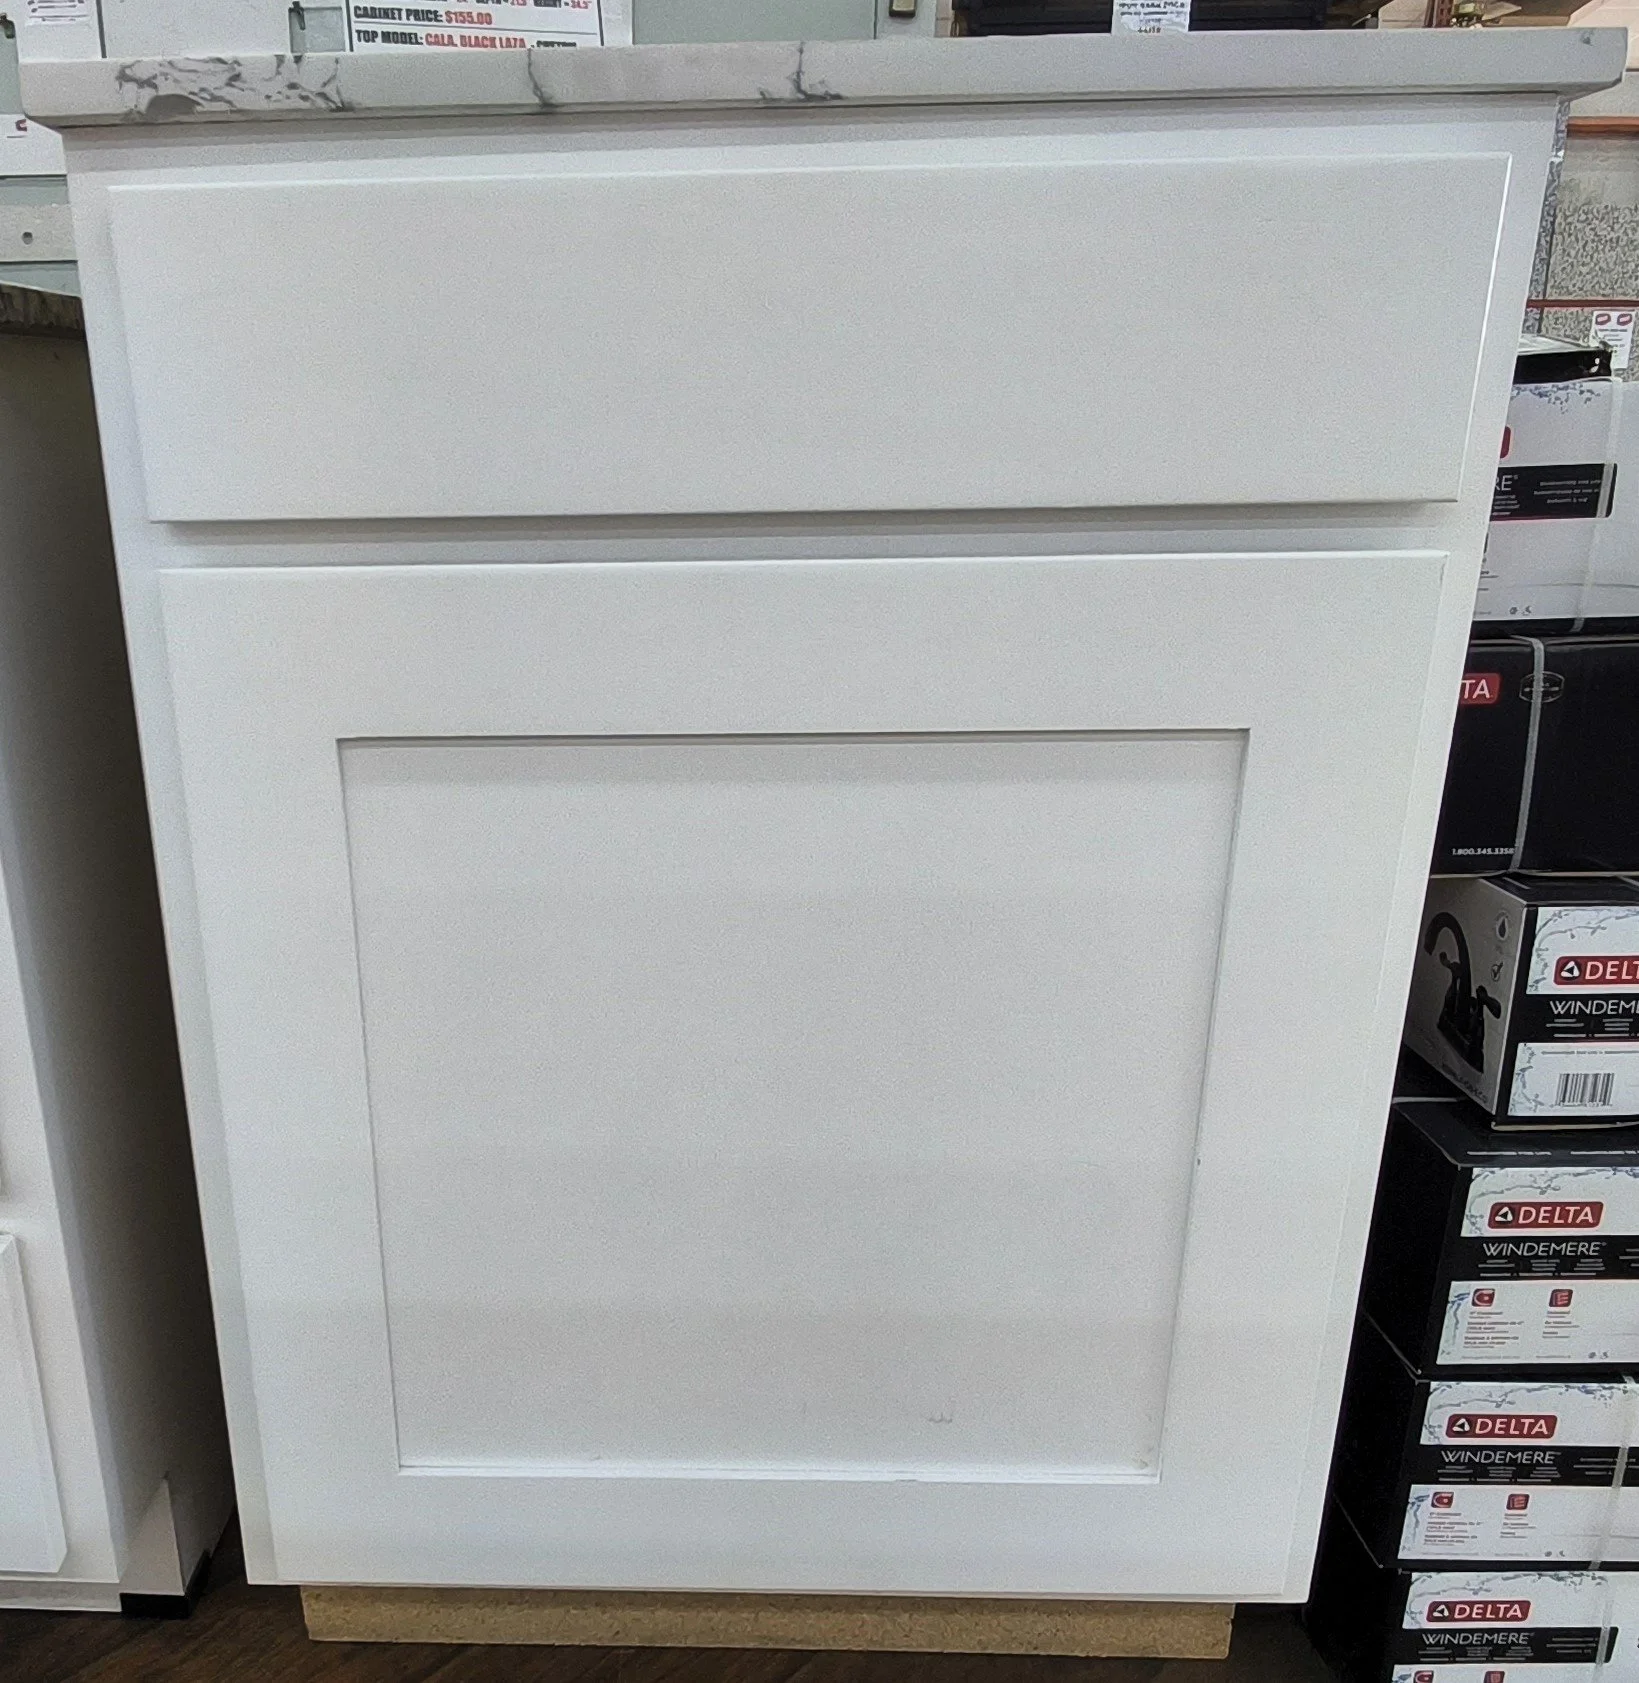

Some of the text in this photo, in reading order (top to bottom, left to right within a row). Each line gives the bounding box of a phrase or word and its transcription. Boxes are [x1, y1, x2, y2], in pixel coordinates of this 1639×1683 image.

[354, 5, 403, 21] CABINET
[444, 10, 493, 26] $155.00
[355, 29, 379, 43] TOP
[381, 30, 424, 46] MODEL:
[460, 34, 497, 49] BLACK
[1549, 999, 1639, 1015] WINDEM
[1518, 1206, 1594, 1225] DELTA
[1483, 1241, 1601, 1257] WINDEMERE
[1475, 1418, 1549, 1435] DELTA
[1441, 1450, 1556, 1464] WINDEMERE
[1454, 1603, 1523, 1619] DELTA
[1422, 1632, 1530, 1645] WINDEMERE
